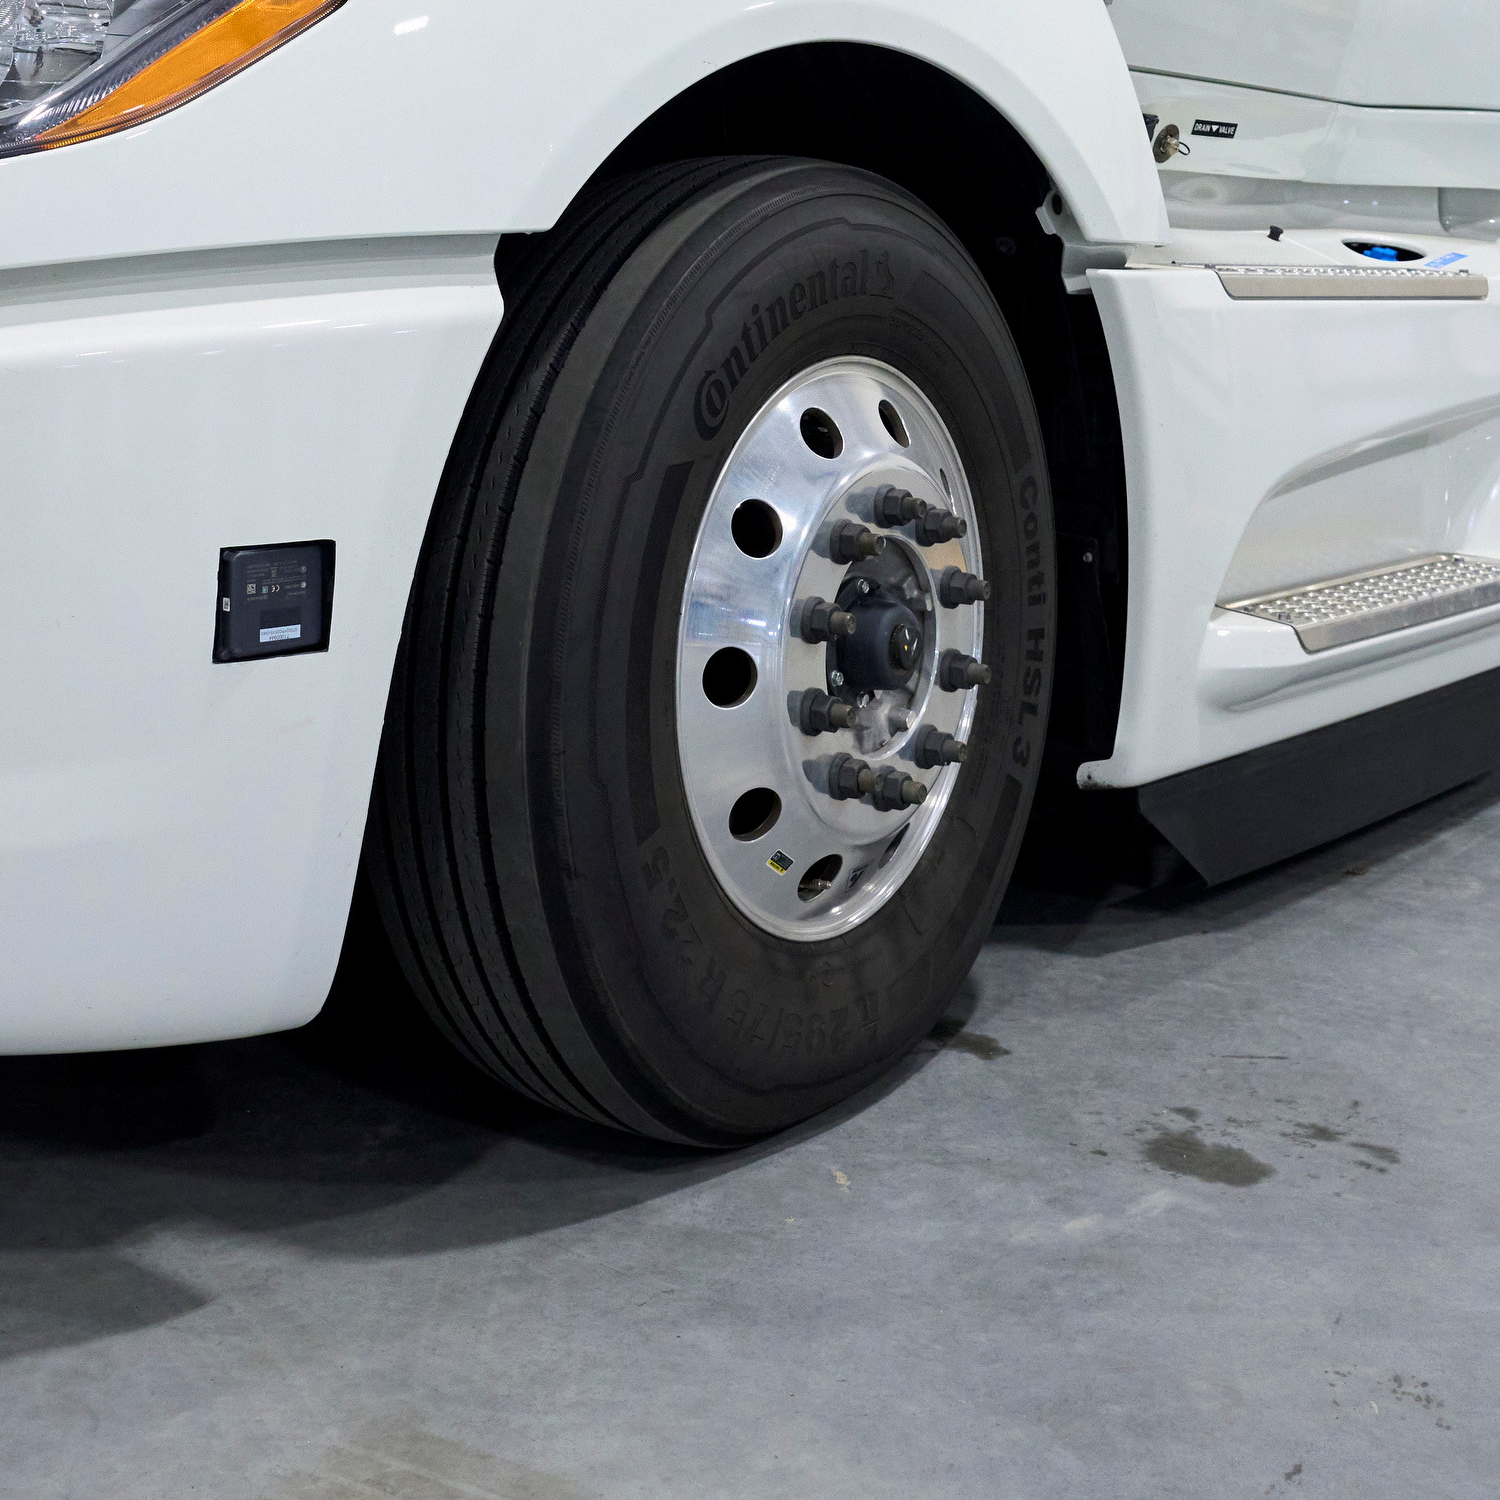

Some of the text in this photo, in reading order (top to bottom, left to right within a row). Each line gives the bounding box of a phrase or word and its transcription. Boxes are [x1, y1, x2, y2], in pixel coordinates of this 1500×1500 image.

[1194, 123, 1235, 134] DRAIN VALVE
[693, 250, 868, 441] Continental
[1011, 475, 1046, 768] Conti HSL 3
